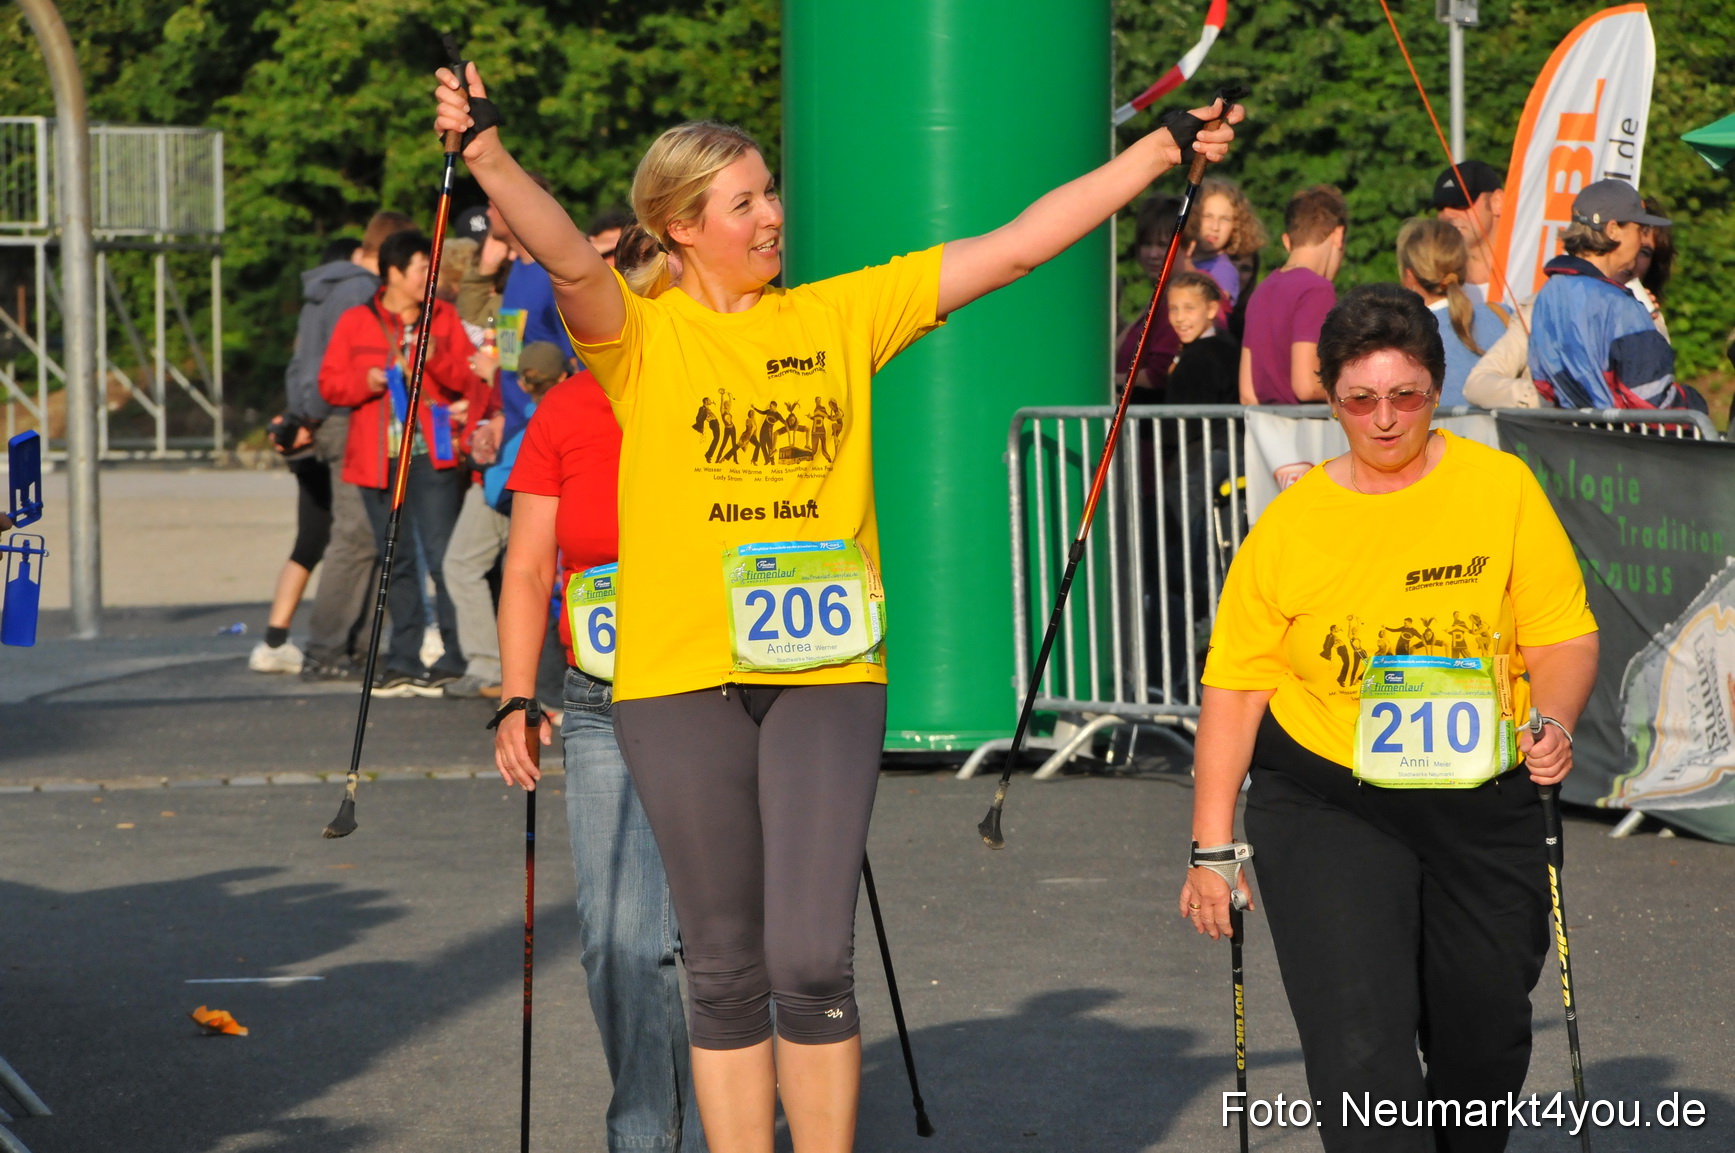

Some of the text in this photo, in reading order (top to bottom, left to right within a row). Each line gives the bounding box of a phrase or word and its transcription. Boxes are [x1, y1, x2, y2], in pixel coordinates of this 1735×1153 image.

[766, 356, 814, 375] swn
[1516, 443, 1640, 514] kologie
[708, 499, 819, 522] Alles läuft
[1618, 515, 1724, 555] Tradition
[746, 568, 796, 581] firmenlauf
[1405, 564, 1463, 586] swn
[1405, 577, 1478, 592] stadtwerke neumarkt
[745, 584, 852, 641] 206
[767, 643, 838, 654] Andrea Werner
[777, 655, 805, 663] Stadtwerke
[1375, 682, 1424, 692] firmenlauf
[1371, 701, 1480, 753] 210
[1400, 756, 1430, 767] Anni
[1548, 863, 1569, 970] nordic
